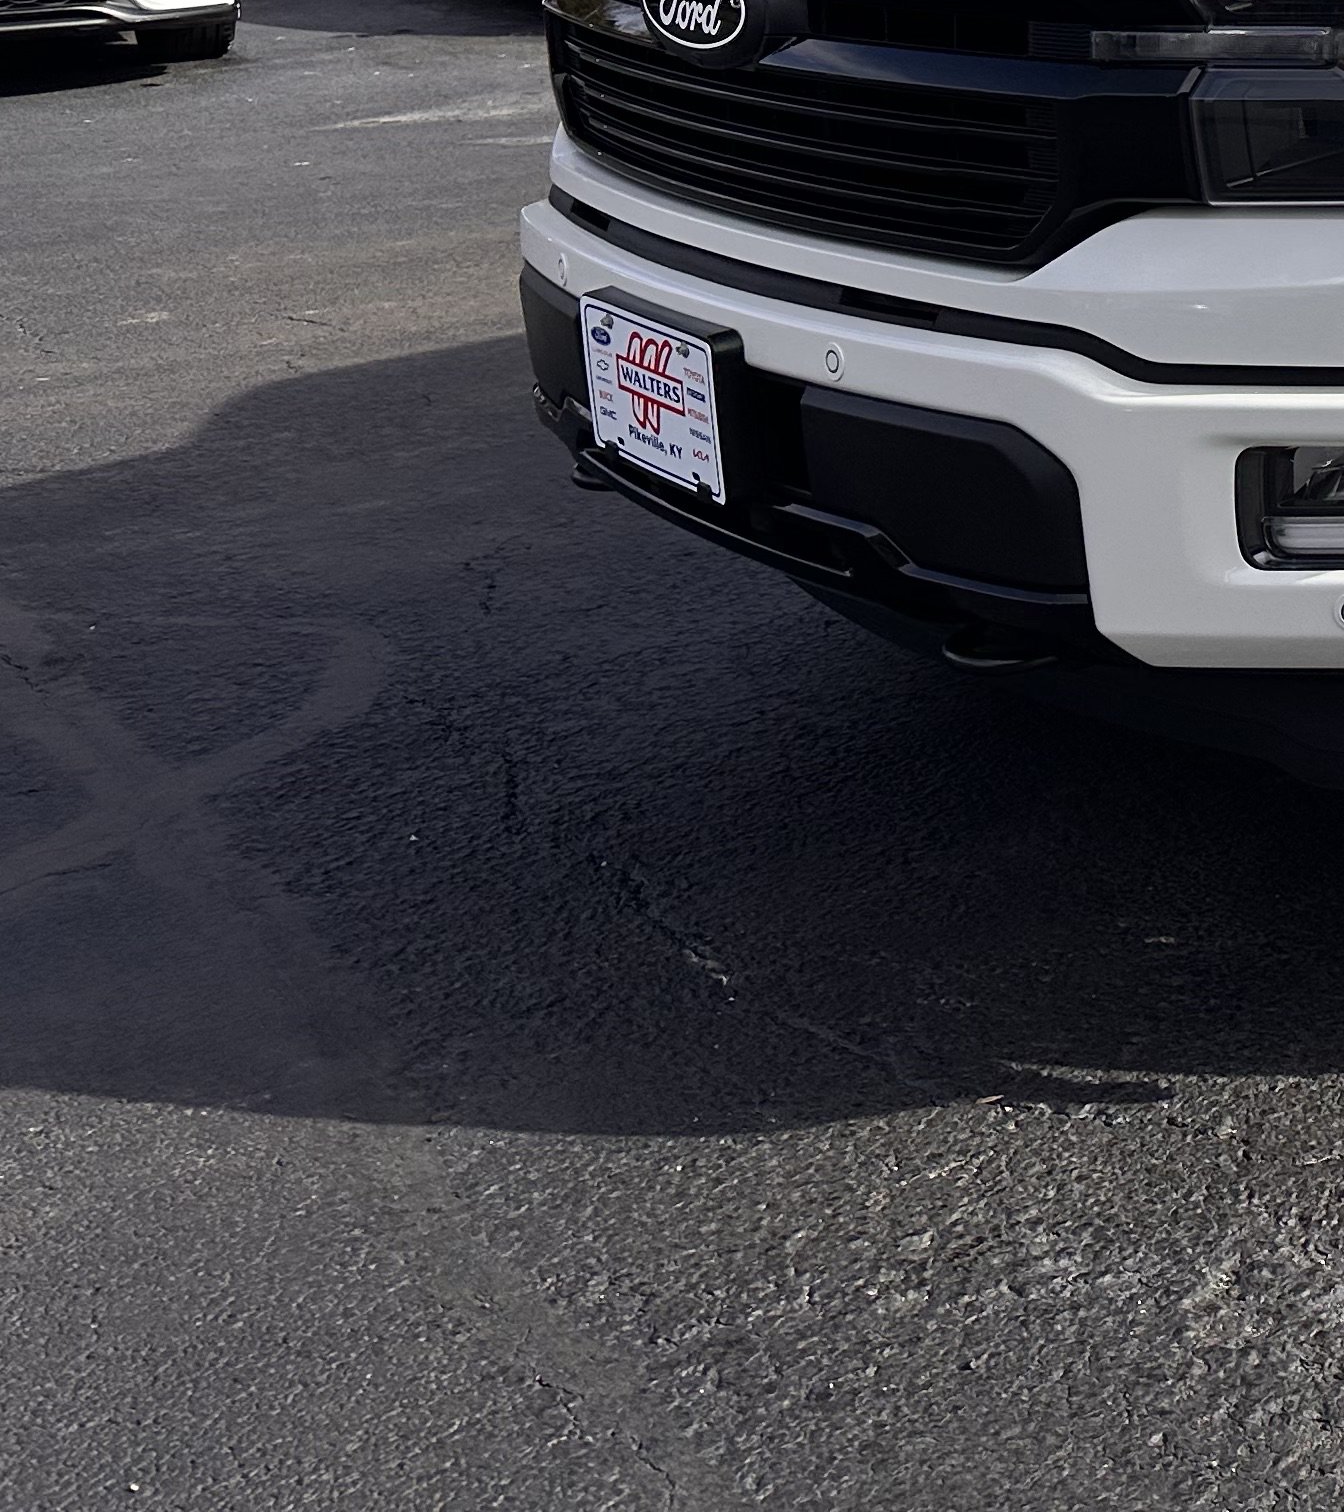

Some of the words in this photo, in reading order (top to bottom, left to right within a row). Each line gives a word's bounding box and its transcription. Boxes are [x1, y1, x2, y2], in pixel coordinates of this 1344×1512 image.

[621, 364, 681, 404] WALTERS
[628, 423, 668, 456] Pikeville,
[669, 442, 683, 460] KY
